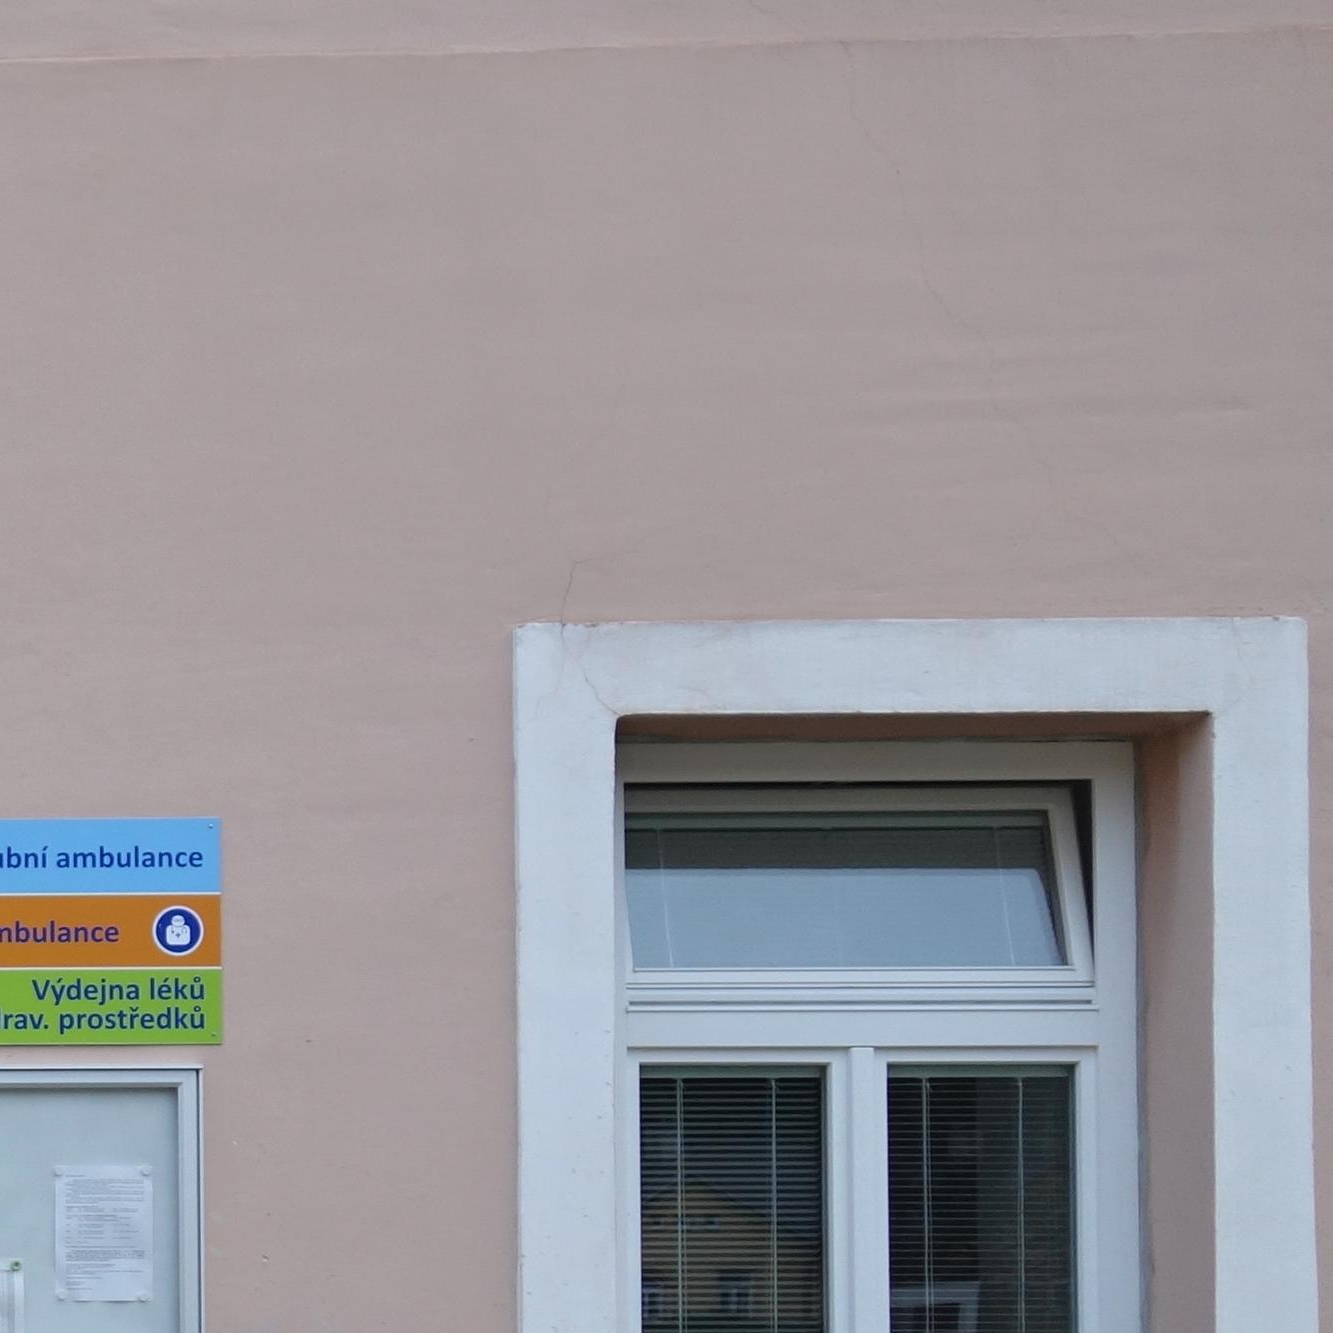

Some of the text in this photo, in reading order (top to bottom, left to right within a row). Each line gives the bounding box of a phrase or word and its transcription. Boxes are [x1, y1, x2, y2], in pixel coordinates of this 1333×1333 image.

[56, 845, 204, 868] ambulance
[32, 976, 205, 1006] Výdejna léků
[59, 1005, 205, 1034] prostředků
